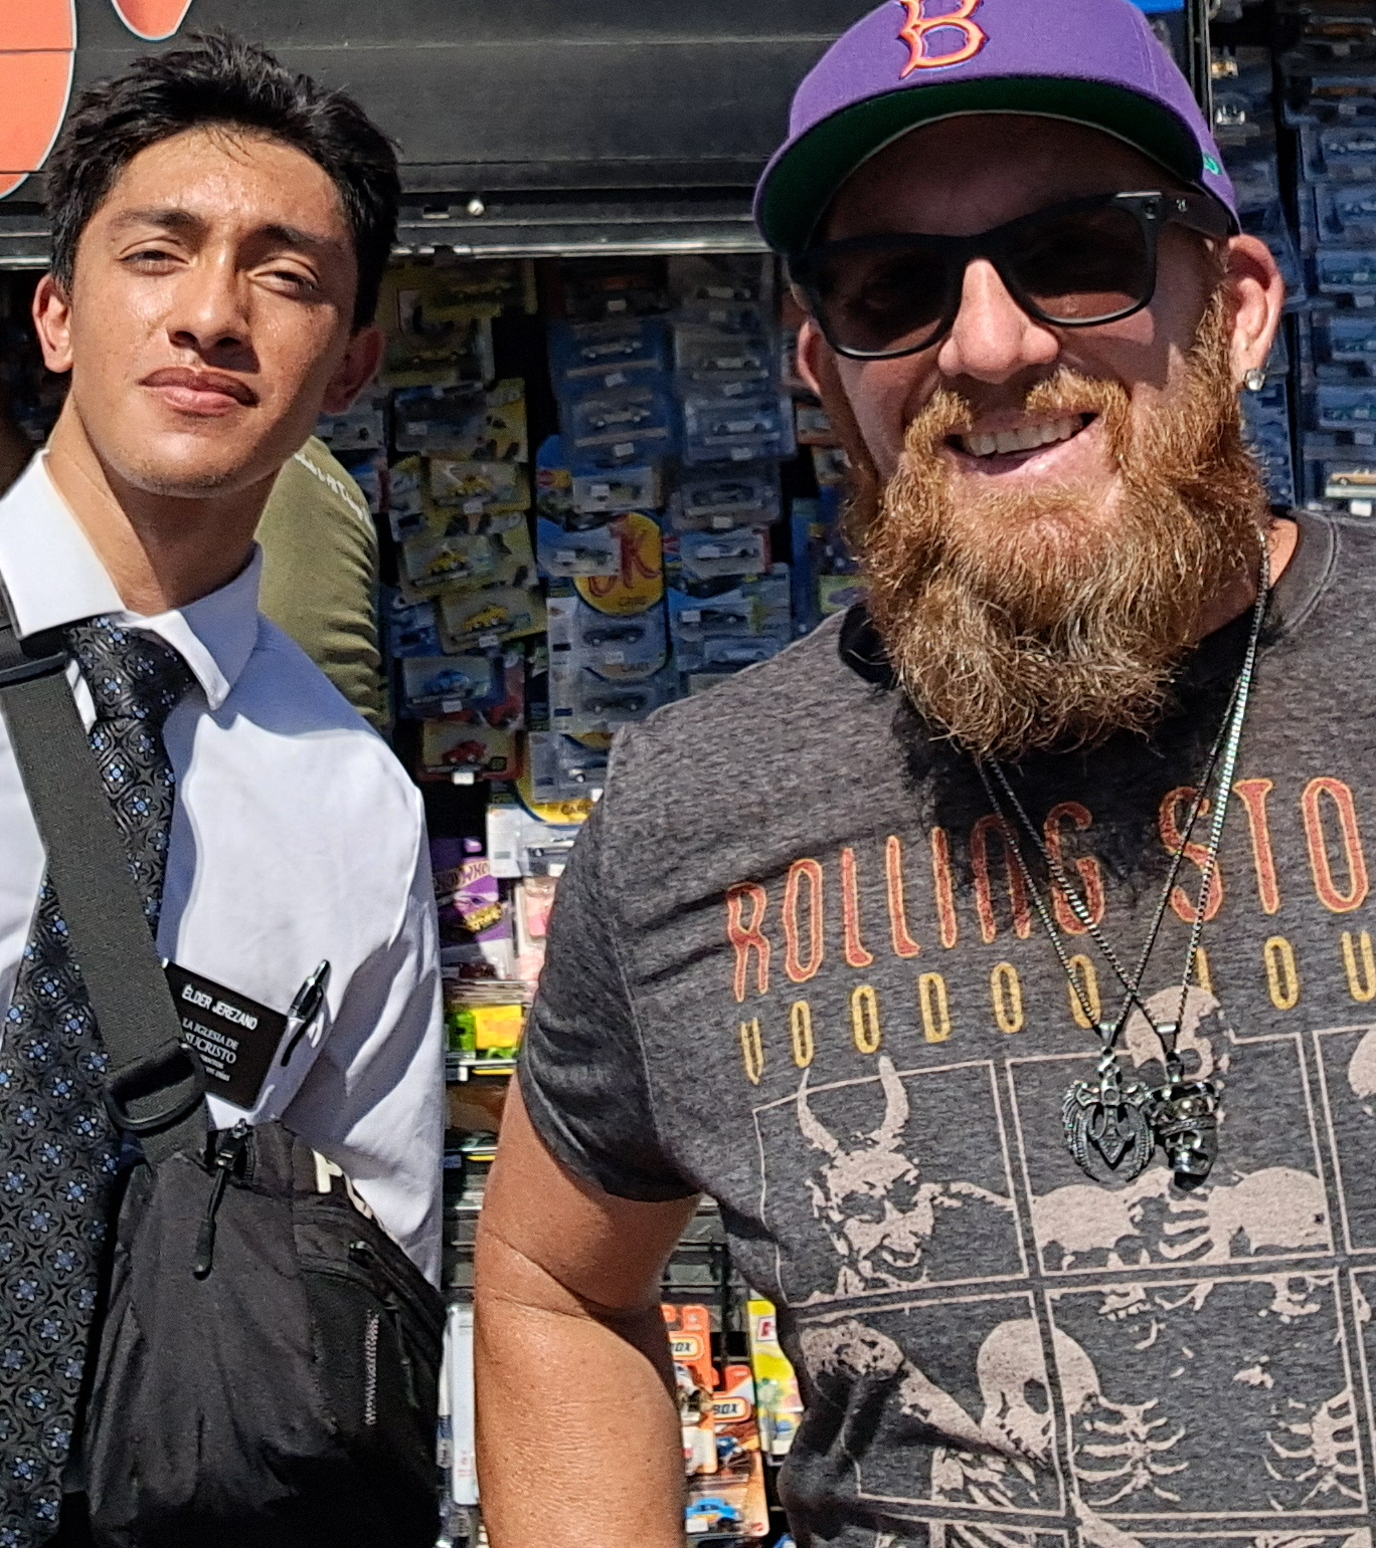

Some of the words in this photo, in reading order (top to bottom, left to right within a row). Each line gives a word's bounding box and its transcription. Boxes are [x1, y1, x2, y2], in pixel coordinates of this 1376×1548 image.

[725, 802, 1106, 1003] ROLLING
[212, 1000, 258, 1031] JEREZANO
[194, 1022, 225, 1044] IGLESIA
[225, 1037, 240, 1051] DE
